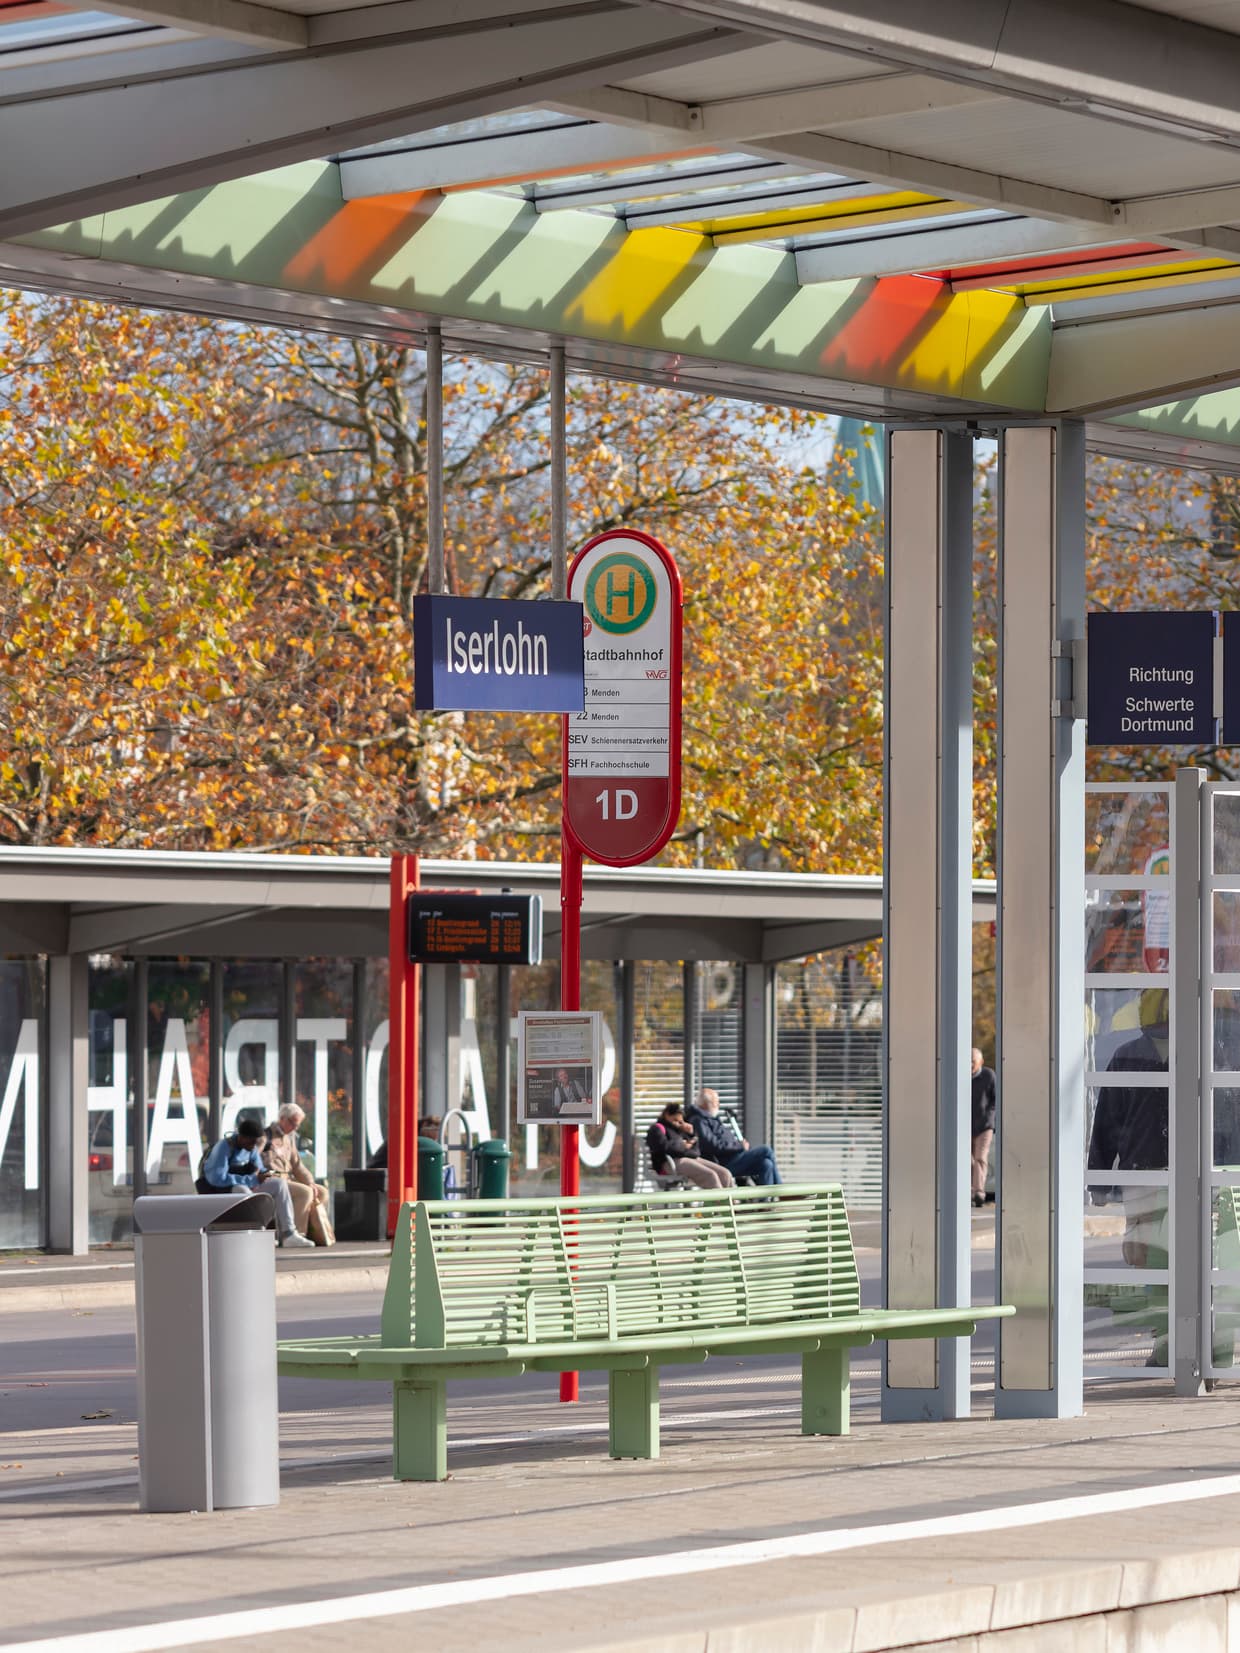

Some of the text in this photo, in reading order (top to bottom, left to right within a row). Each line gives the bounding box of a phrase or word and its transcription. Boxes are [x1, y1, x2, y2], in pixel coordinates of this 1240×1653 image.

[446, 618, 548, 675] Iserlohn
[584, 648, 664, 661] tadtbahnhof
[1129, 667, 1194, 685] Richtung
[591, 689, 620, 697] Menden
[1126, 697, 1194, 712] Schwerte
[591, 713, 620, 721] Menden
[1121, 716, 1194, 732] Dortmund
[568, 735, 668, 745] SEV Schienenersatzverkehr
[568, 759, 650, 769] SFH Fachhochschule
[596, 789, 639, 820] 1D
